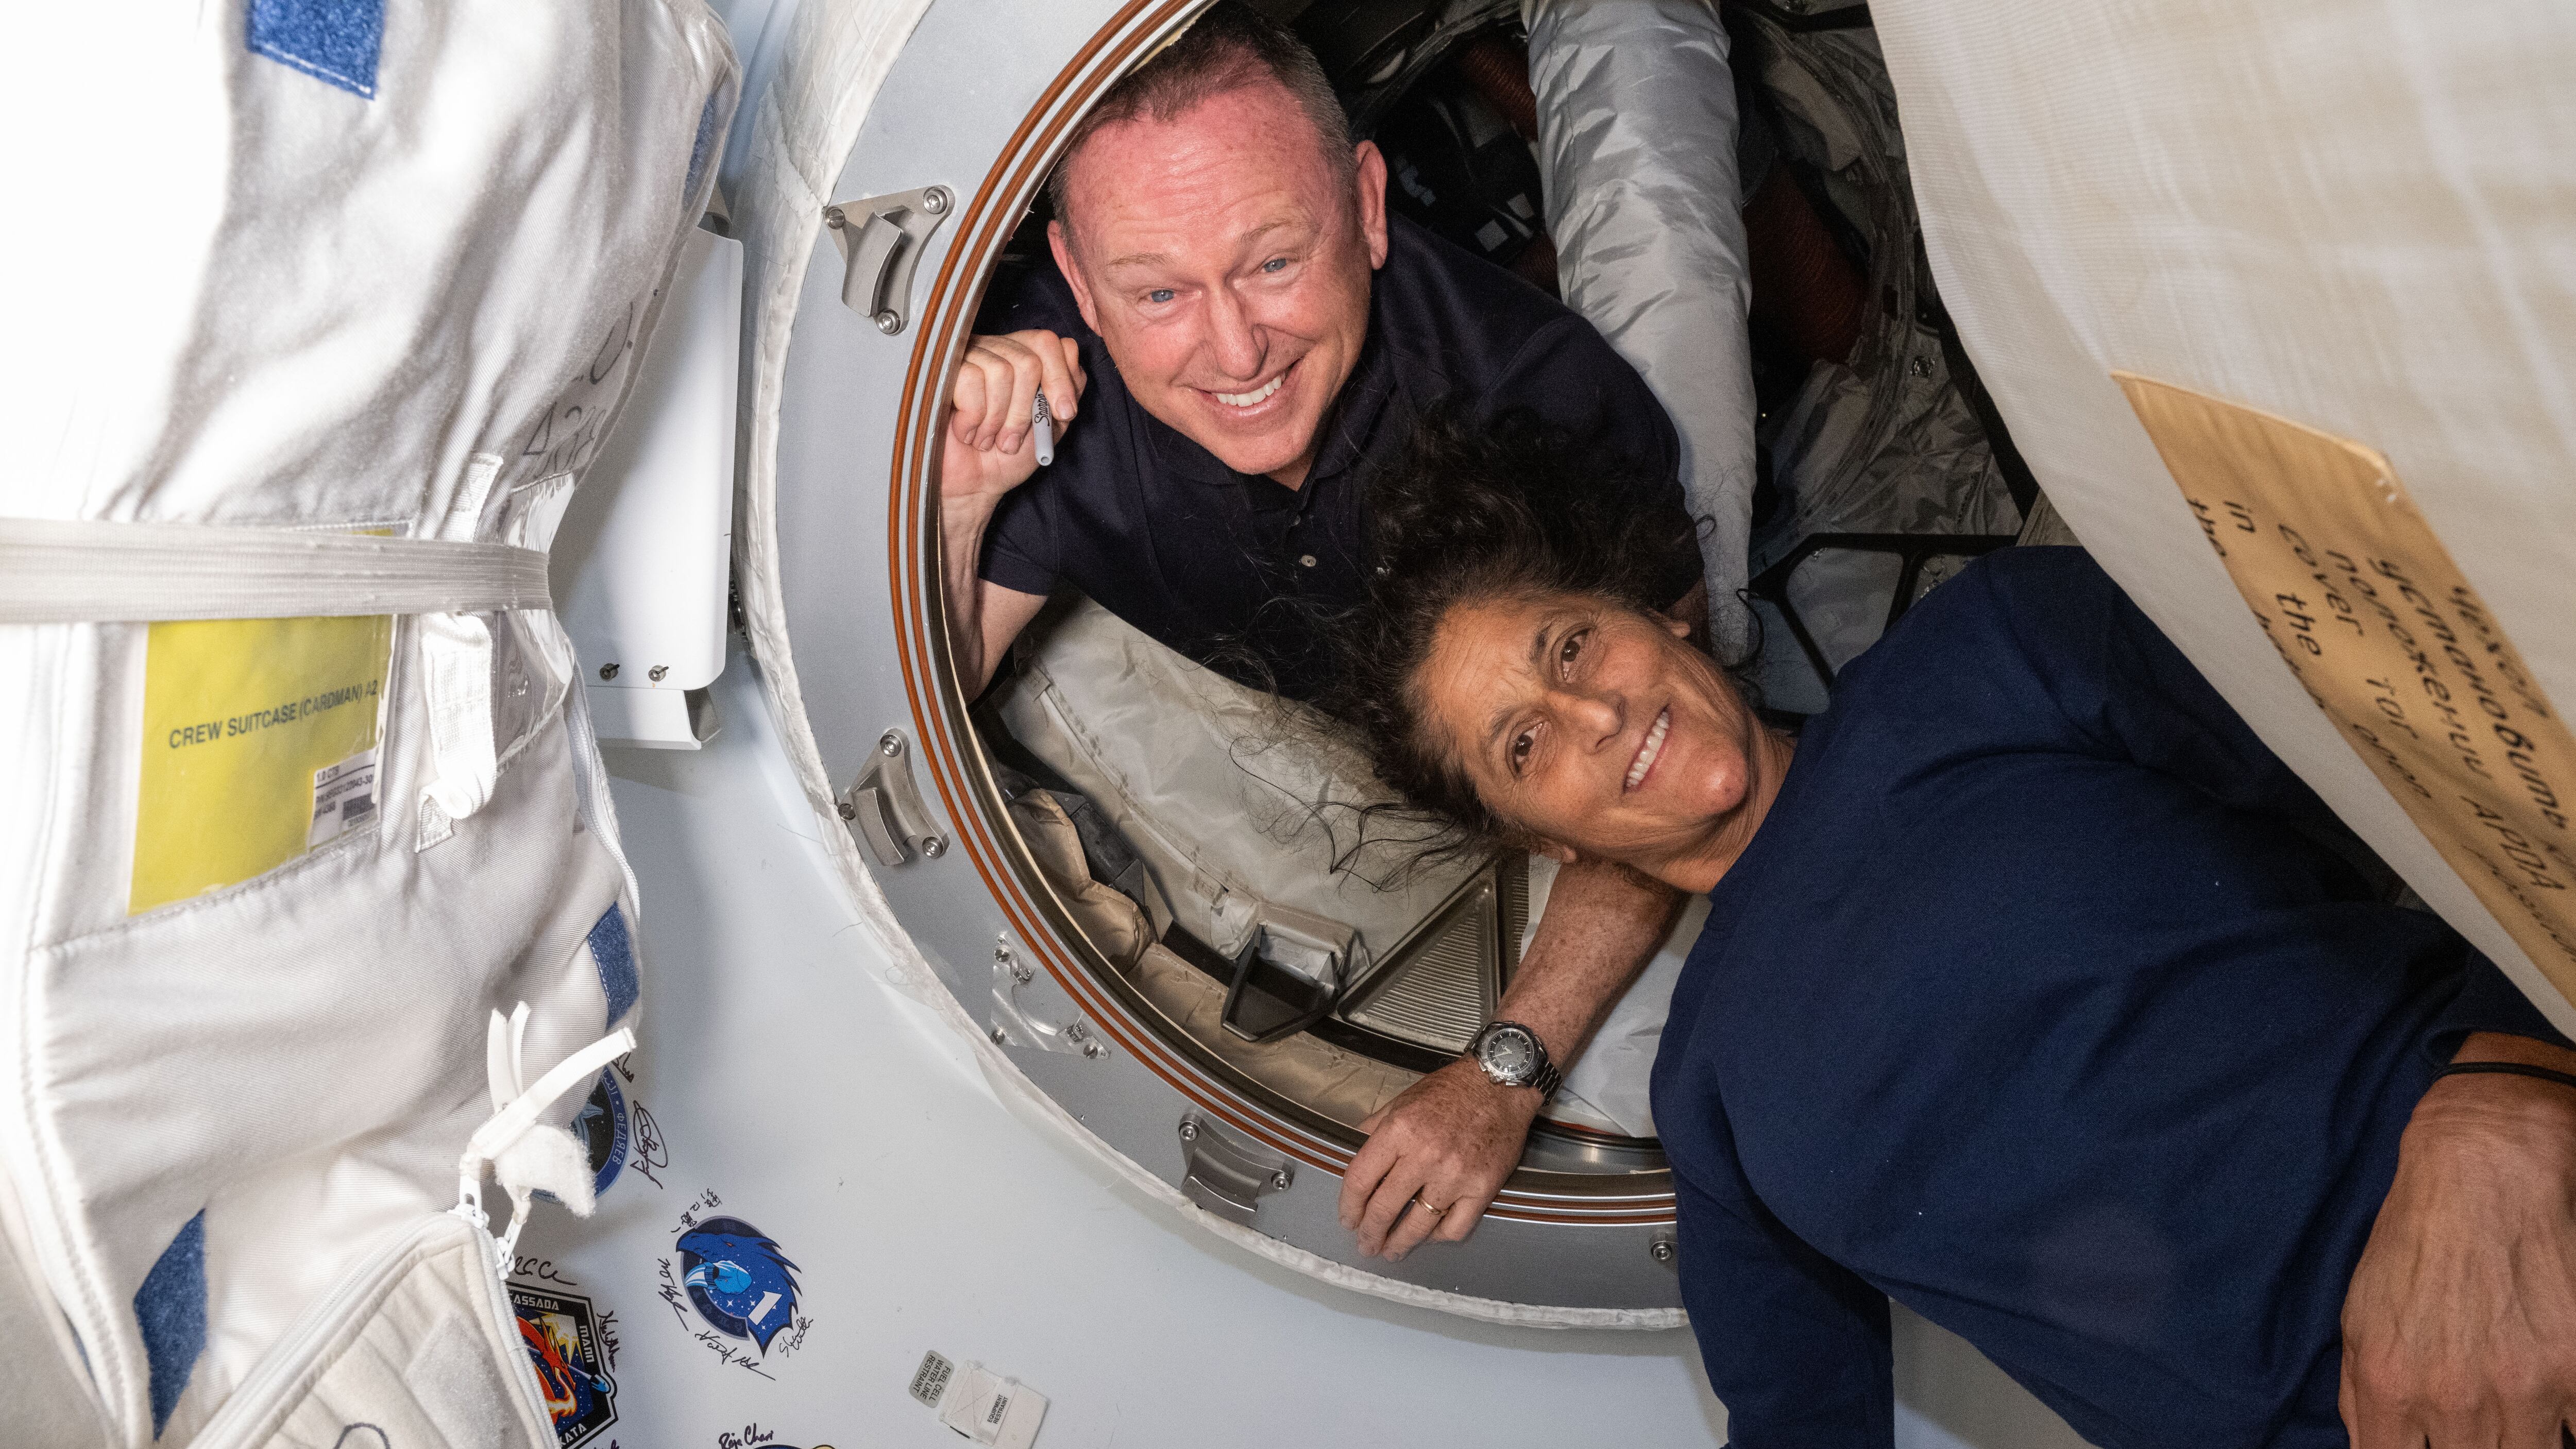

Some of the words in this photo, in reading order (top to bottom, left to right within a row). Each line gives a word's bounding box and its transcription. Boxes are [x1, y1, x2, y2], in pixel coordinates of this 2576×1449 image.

[1035, 394, 1050, 427] Sharpie
[2224, 501, 2256, 533] in
[2276, 592, 2322, 656] the
[2278, 523, 2364, 637] cover
[2367, 557, 2570, 830] установить
[169, 721, 223, 749] CREW
[227, 702, 297, 737] SUITCASE
[299, 683, 363, 720] (CARDMAN)
[612, 1112, 625, 1166] ФЕДЯЕВ
[748, 1290, 783, 1326] 1
[913, 1355, 935, 1393] RESTRAINT
[928, 1359, 944, 1383] WATER
[938, 1366, 951, 1383] FUEL
[920, 1382, 933, 1400] LINE
[928, 1384, 942, 1401] CELL
[987, 1394, 1004, 1423] EQUIPMENT
[993, 1396, 1009, 1424] RESTRAINT
